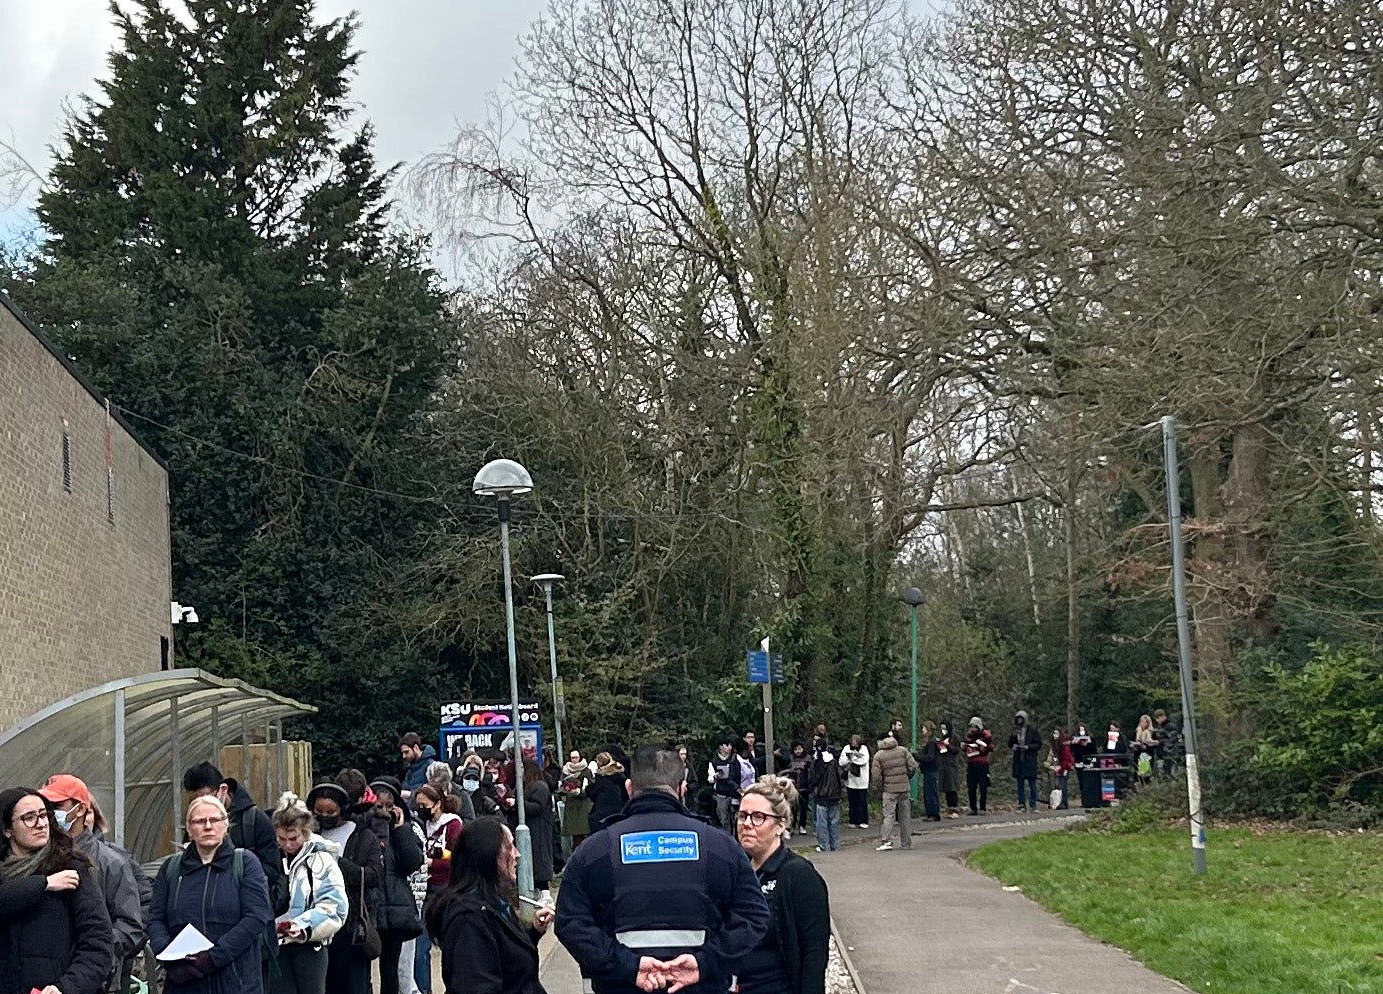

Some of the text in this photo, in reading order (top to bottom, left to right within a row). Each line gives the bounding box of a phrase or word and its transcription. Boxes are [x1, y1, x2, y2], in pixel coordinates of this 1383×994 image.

[440, 702, 471, 716] KSU
[657, 836, 694, 845] Campus
[625, 843, 652, 856] Kent
[658, 846, 695, 855] Security
